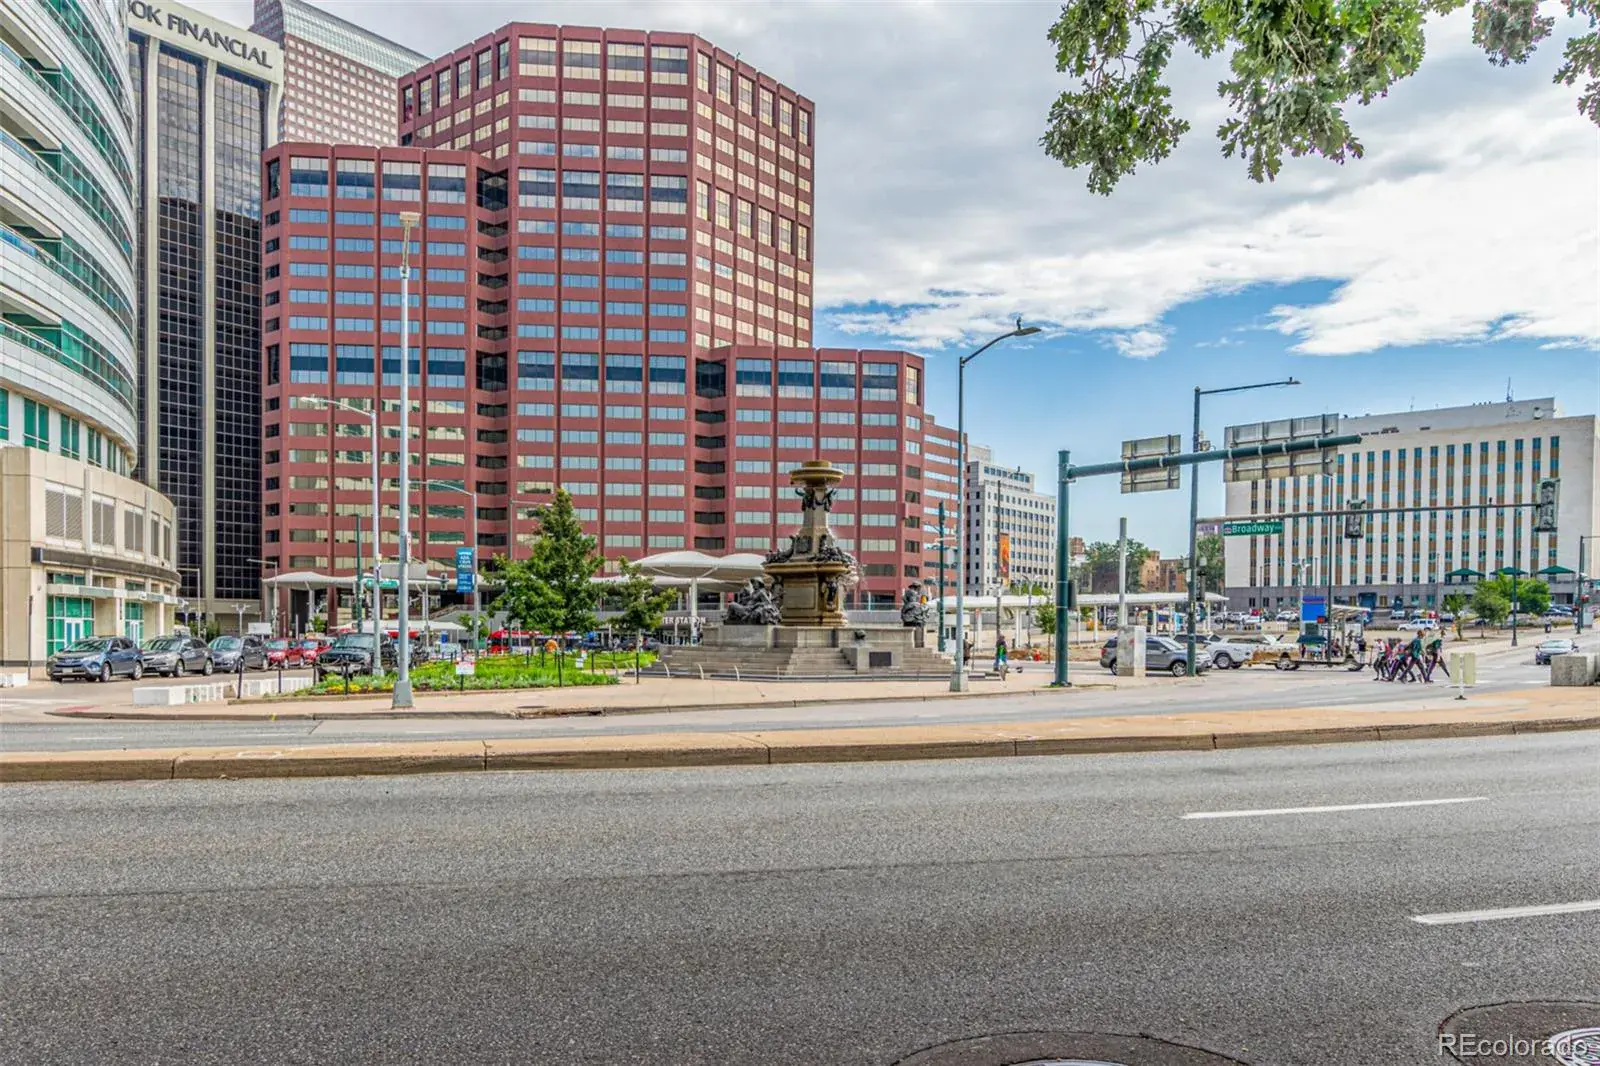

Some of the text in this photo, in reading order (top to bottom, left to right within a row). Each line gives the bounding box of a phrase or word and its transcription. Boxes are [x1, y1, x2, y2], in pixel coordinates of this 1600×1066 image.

[128, 0, 273, 69] OK FINANCIAL
[1231, 524, 1275, 534] Broadway
[675, 616, 706, 624] STATON
